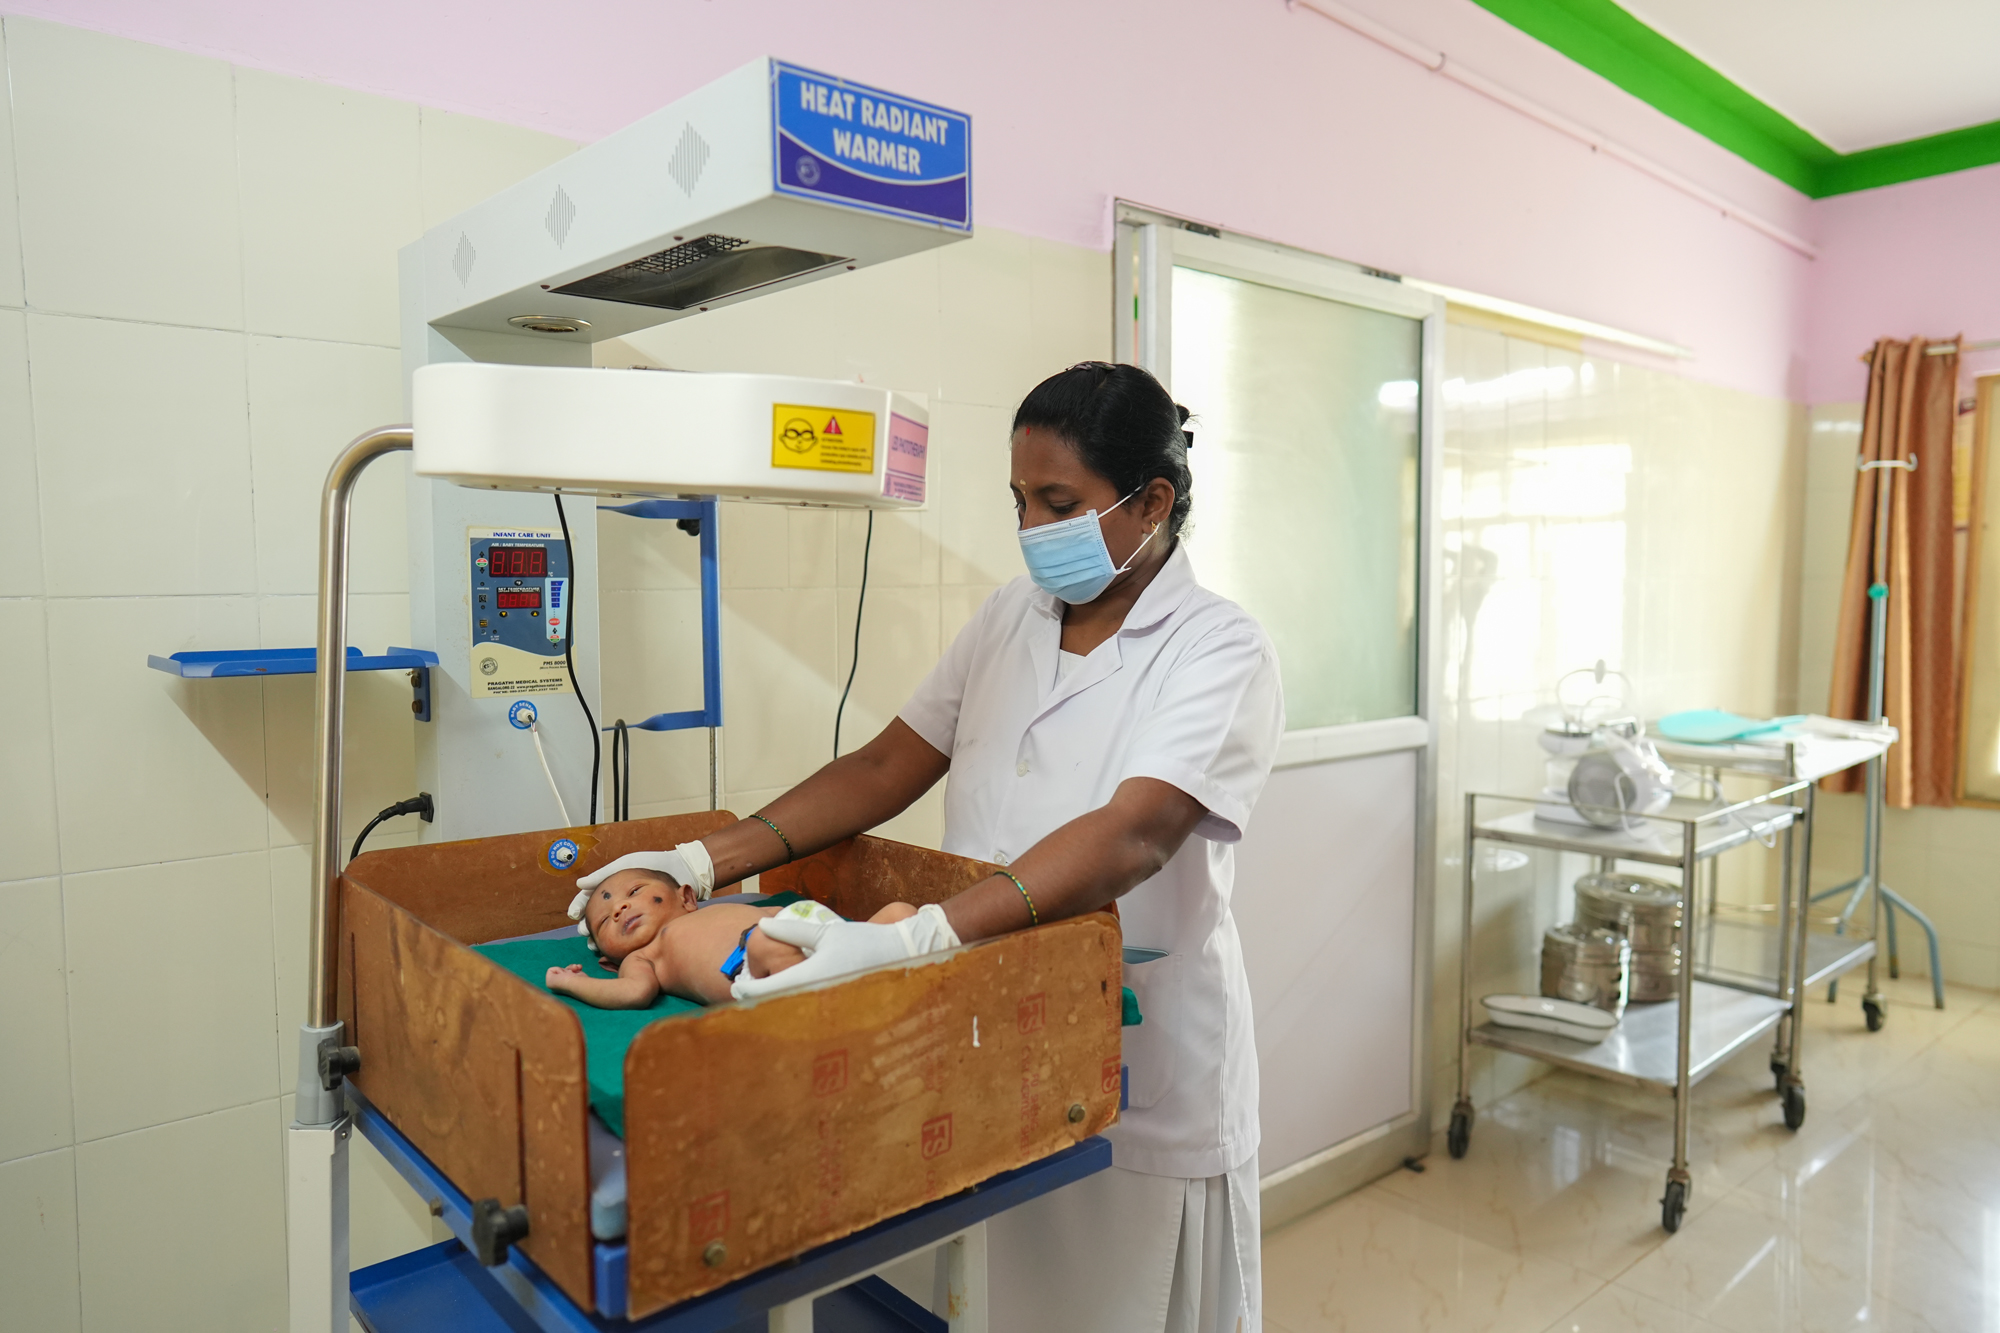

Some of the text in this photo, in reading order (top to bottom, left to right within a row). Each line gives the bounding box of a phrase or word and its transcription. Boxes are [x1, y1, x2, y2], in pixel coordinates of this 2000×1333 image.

[801, 81, 948, 146] HEAT RADIANT
[833, 128, 922, 176] WARMER
[550, 842, 576, 859] DO NOT COVER
[1019, 997, 1039, 1034] FS
[1020, 1077, 1030, 1121] ACRYLIC
[1031, 1093, 1039, 1132] SHENG
[924, 1116, 949, 1158] FS
[1020, 1125, 1031, 1157] SHEET
